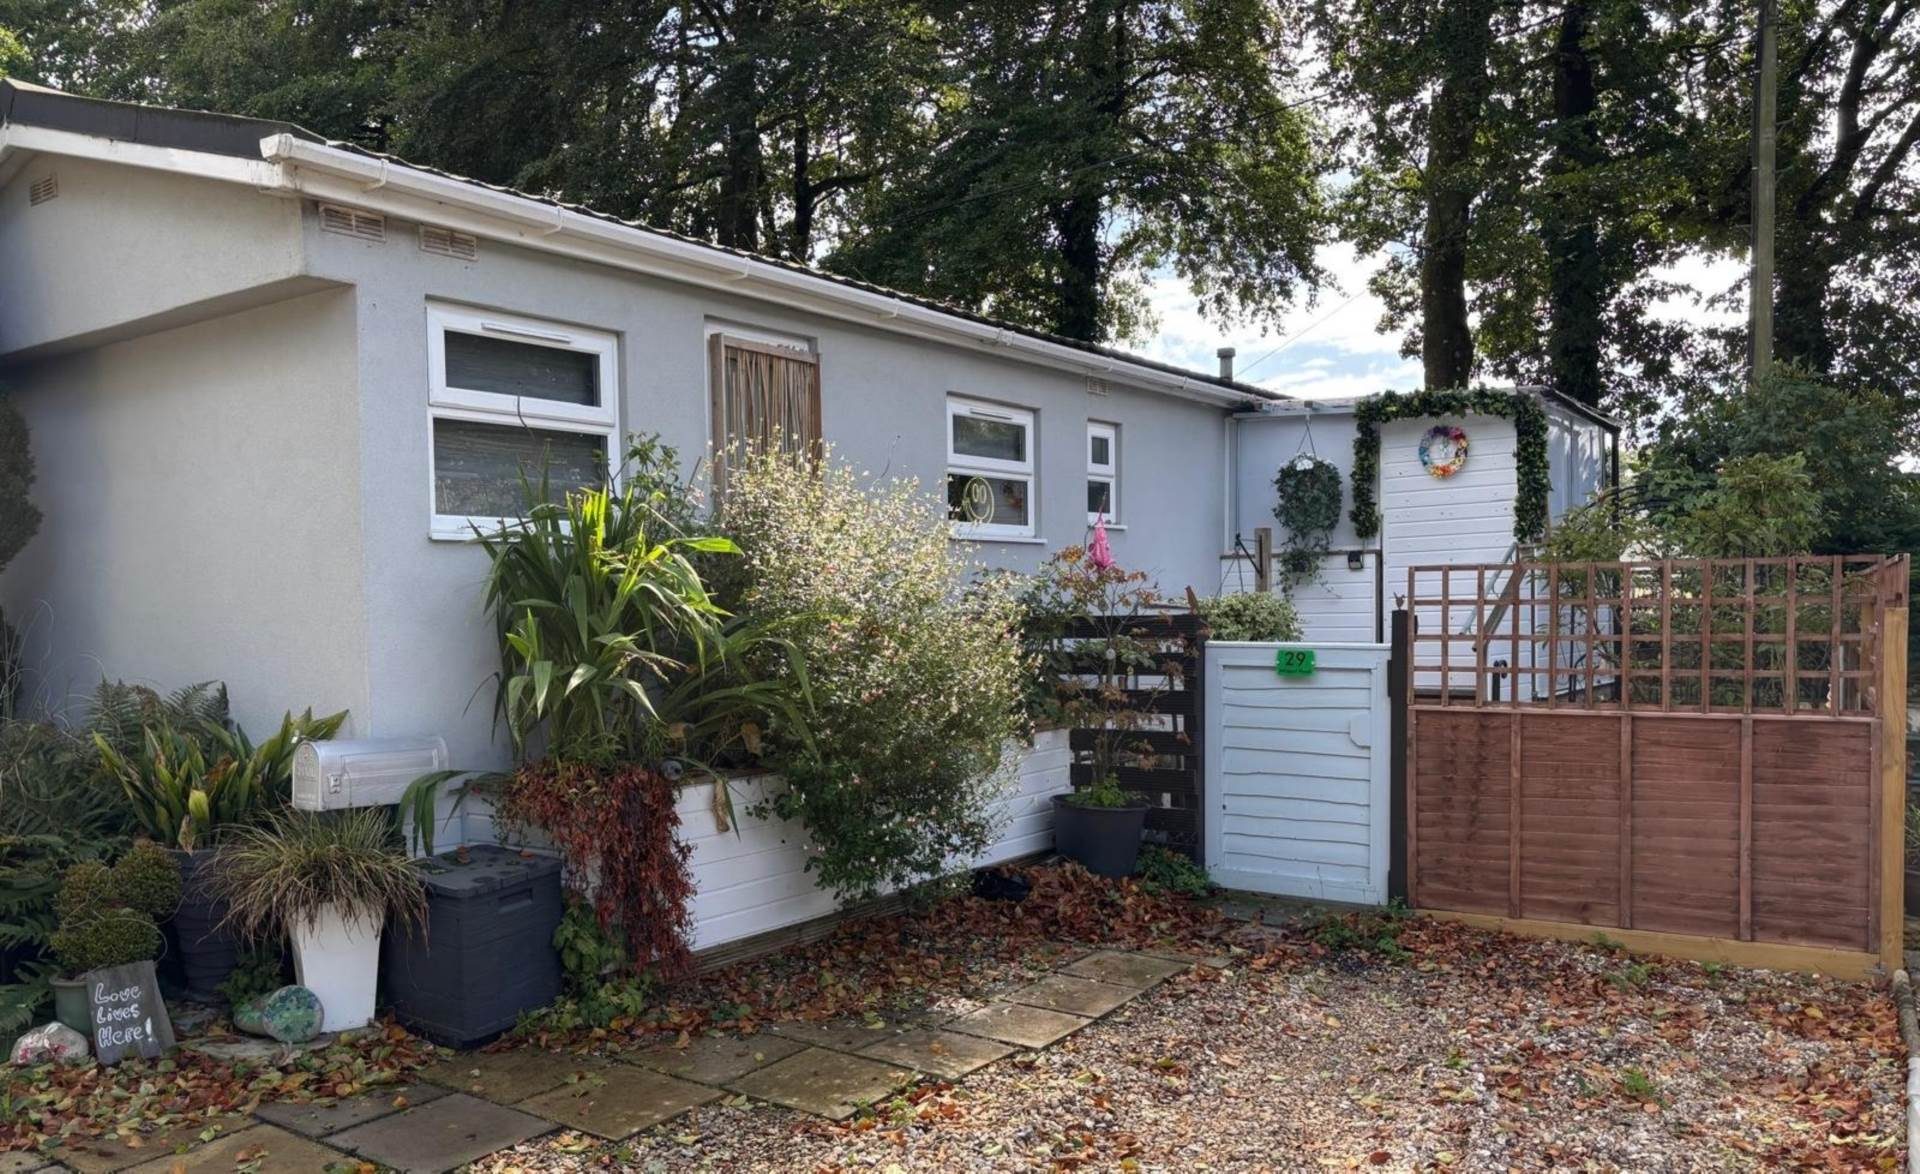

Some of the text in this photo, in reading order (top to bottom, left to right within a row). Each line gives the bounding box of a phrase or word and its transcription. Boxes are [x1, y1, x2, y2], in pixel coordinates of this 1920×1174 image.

[1285, 651, 1306, 666] 29
[95, 982, 141, 1004] Love
[96, 1003, 140, 1023] Lives
[98, 1016, 152, 1048] Here!
